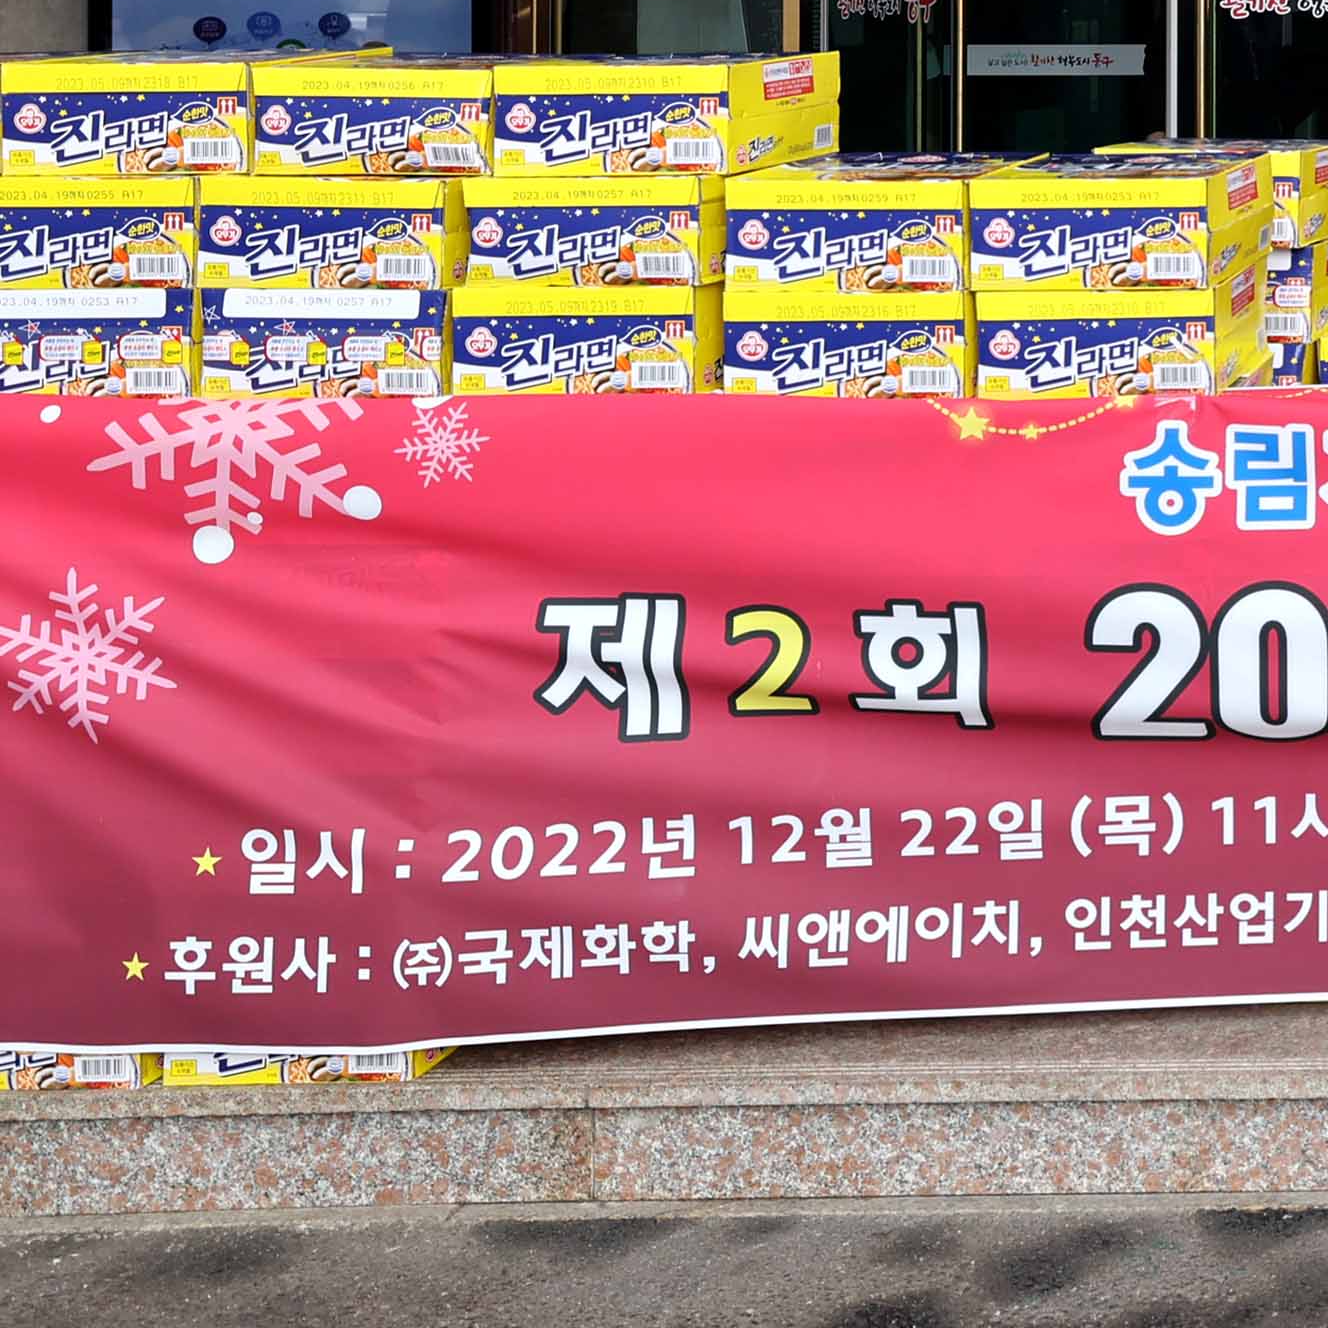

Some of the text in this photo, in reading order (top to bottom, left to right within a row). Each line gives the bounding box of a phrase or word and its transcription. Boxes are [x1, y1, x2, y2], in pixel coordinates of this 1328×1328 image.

[50, 110, 169, 168] 진라면
[245, 225, 364, 281] 진라면
[507, 225, 622, 281] 진라면
[1019, 225, 1133, 282] 진라면
[533, 592, 691, 742] 제
[724, 604, 821, 717] 2
[848, 598, 996, 730] 회
[239, 826, 367, 895] 일시
[440, 812, 697, 884] 2022년
[727, 806, 873, 870] 12월
[899, 798, 1045, 861] 22일
[1069, 791, 1186, 858] (목)
[163, 934, 337, 995] 후원사
[737, 899, 1045, 970] 씨앤에이치,
